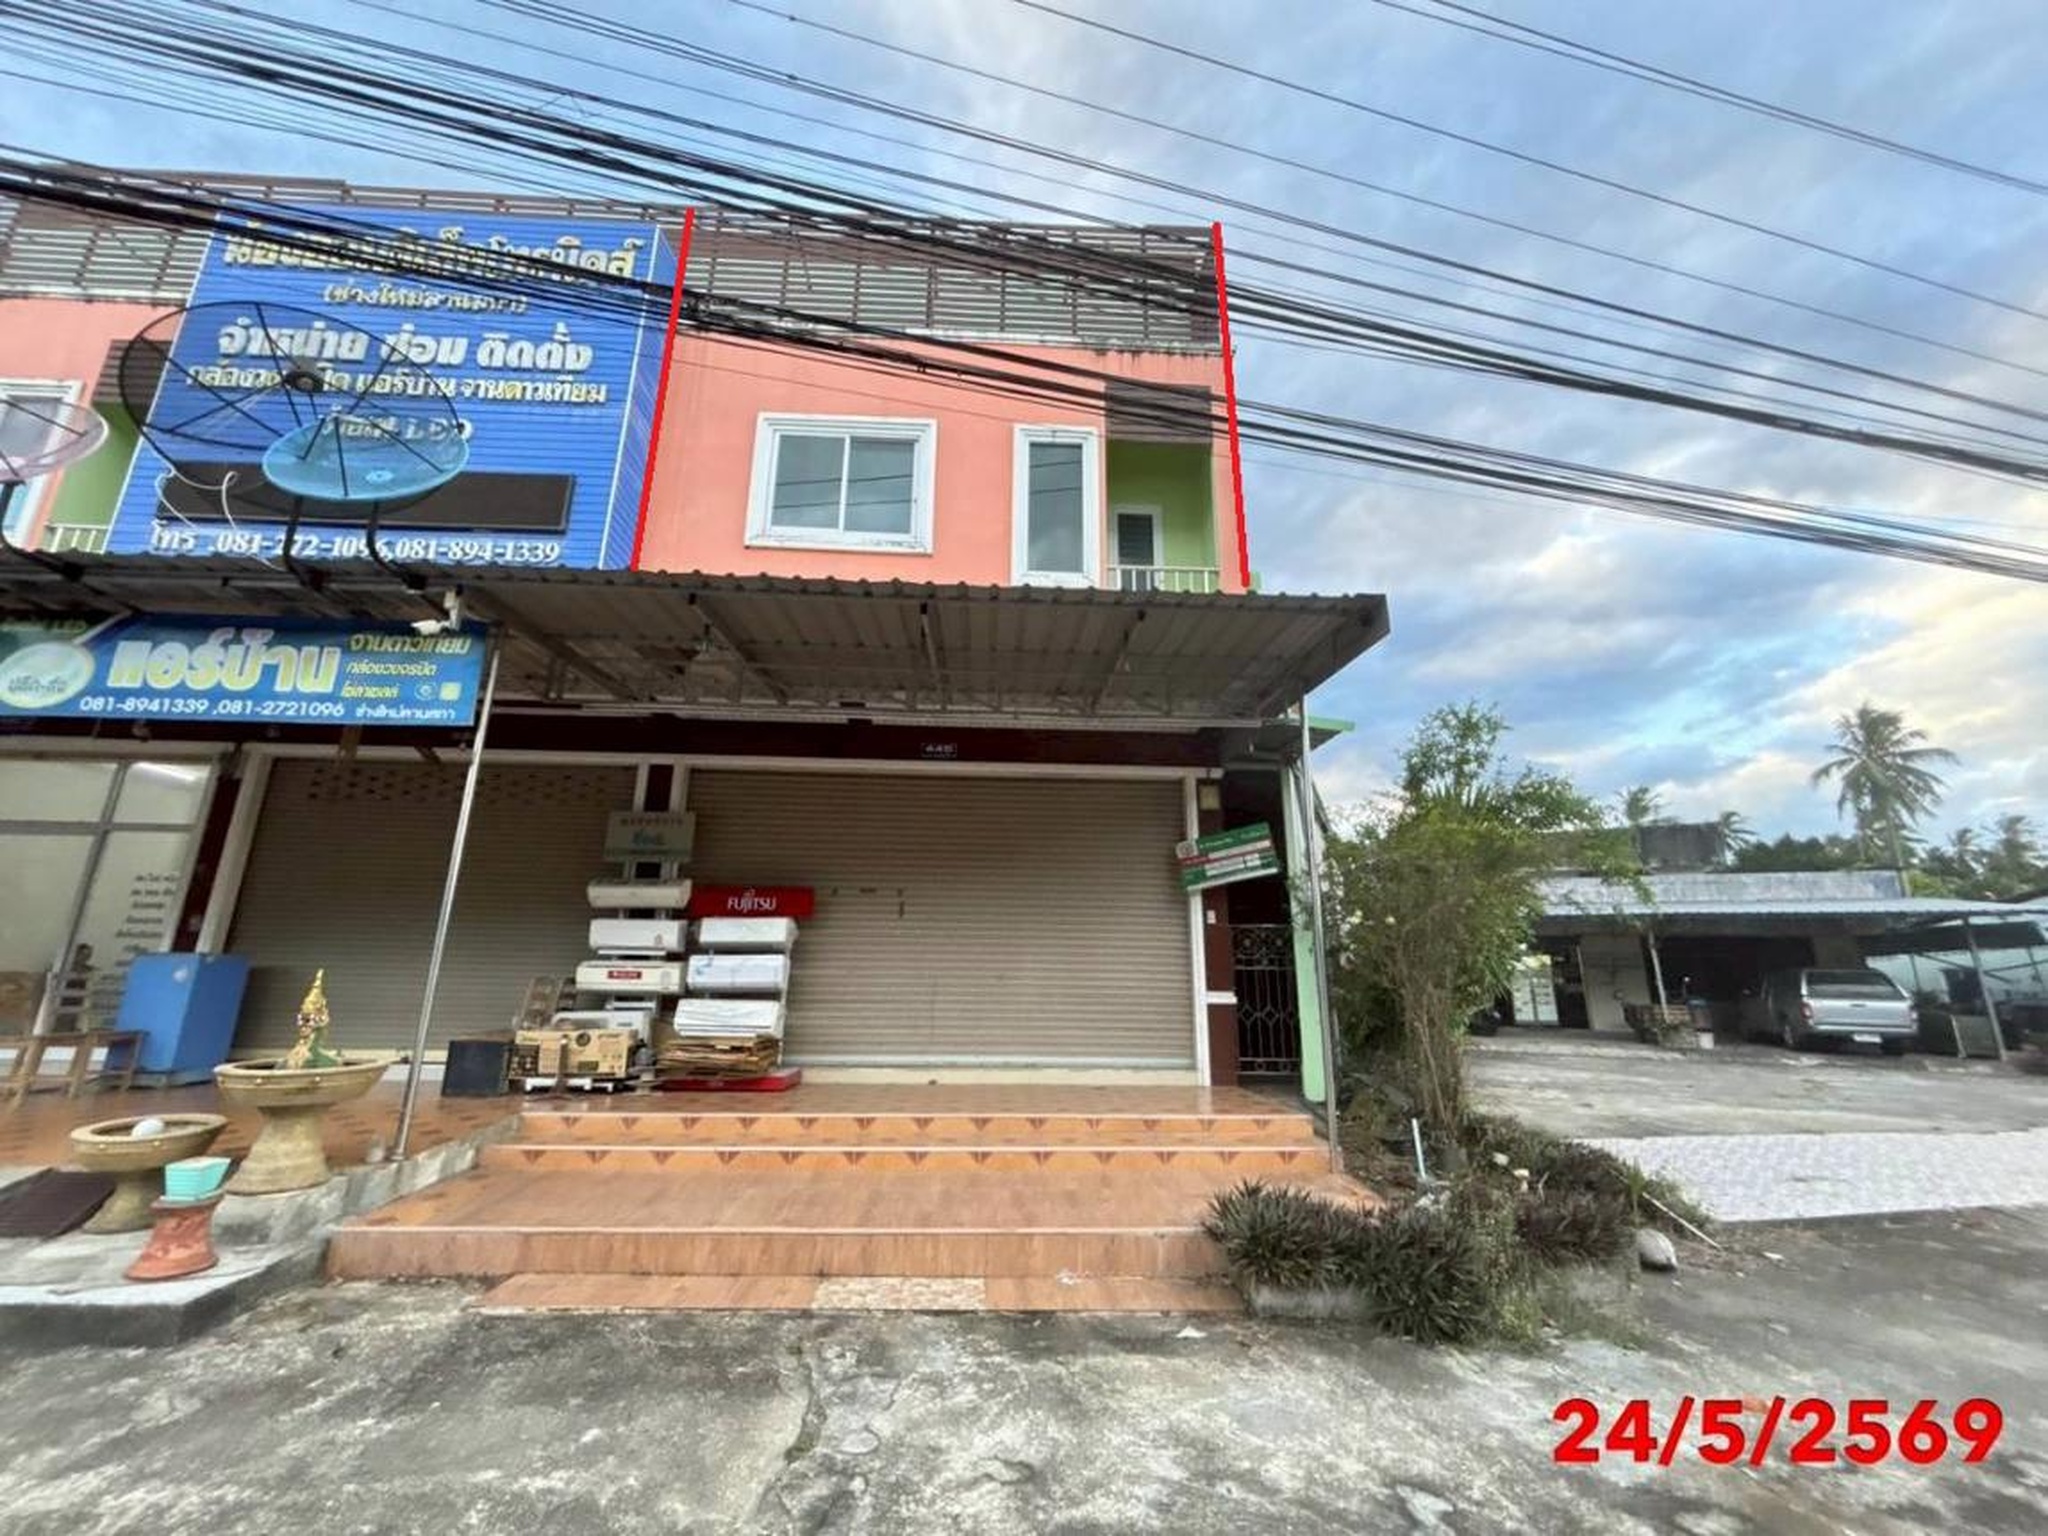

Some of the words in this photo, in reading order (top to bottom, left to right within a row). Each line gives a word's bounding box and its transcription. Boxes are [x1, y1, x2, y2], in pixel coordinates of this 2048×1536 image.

[218, 317, 369, 361] จำหน่าย
[380, 323, 468, 366] ซ่อม
[476, 322, 594, 371] ติดตั้ง
[460, 374, 607, 403] จานดาวเทียม
[151, 518, 197, 549] โทร
[107, 628, 342, 695] แอร์บ้าน
[727, 892, 777, 913] FUJITSU
